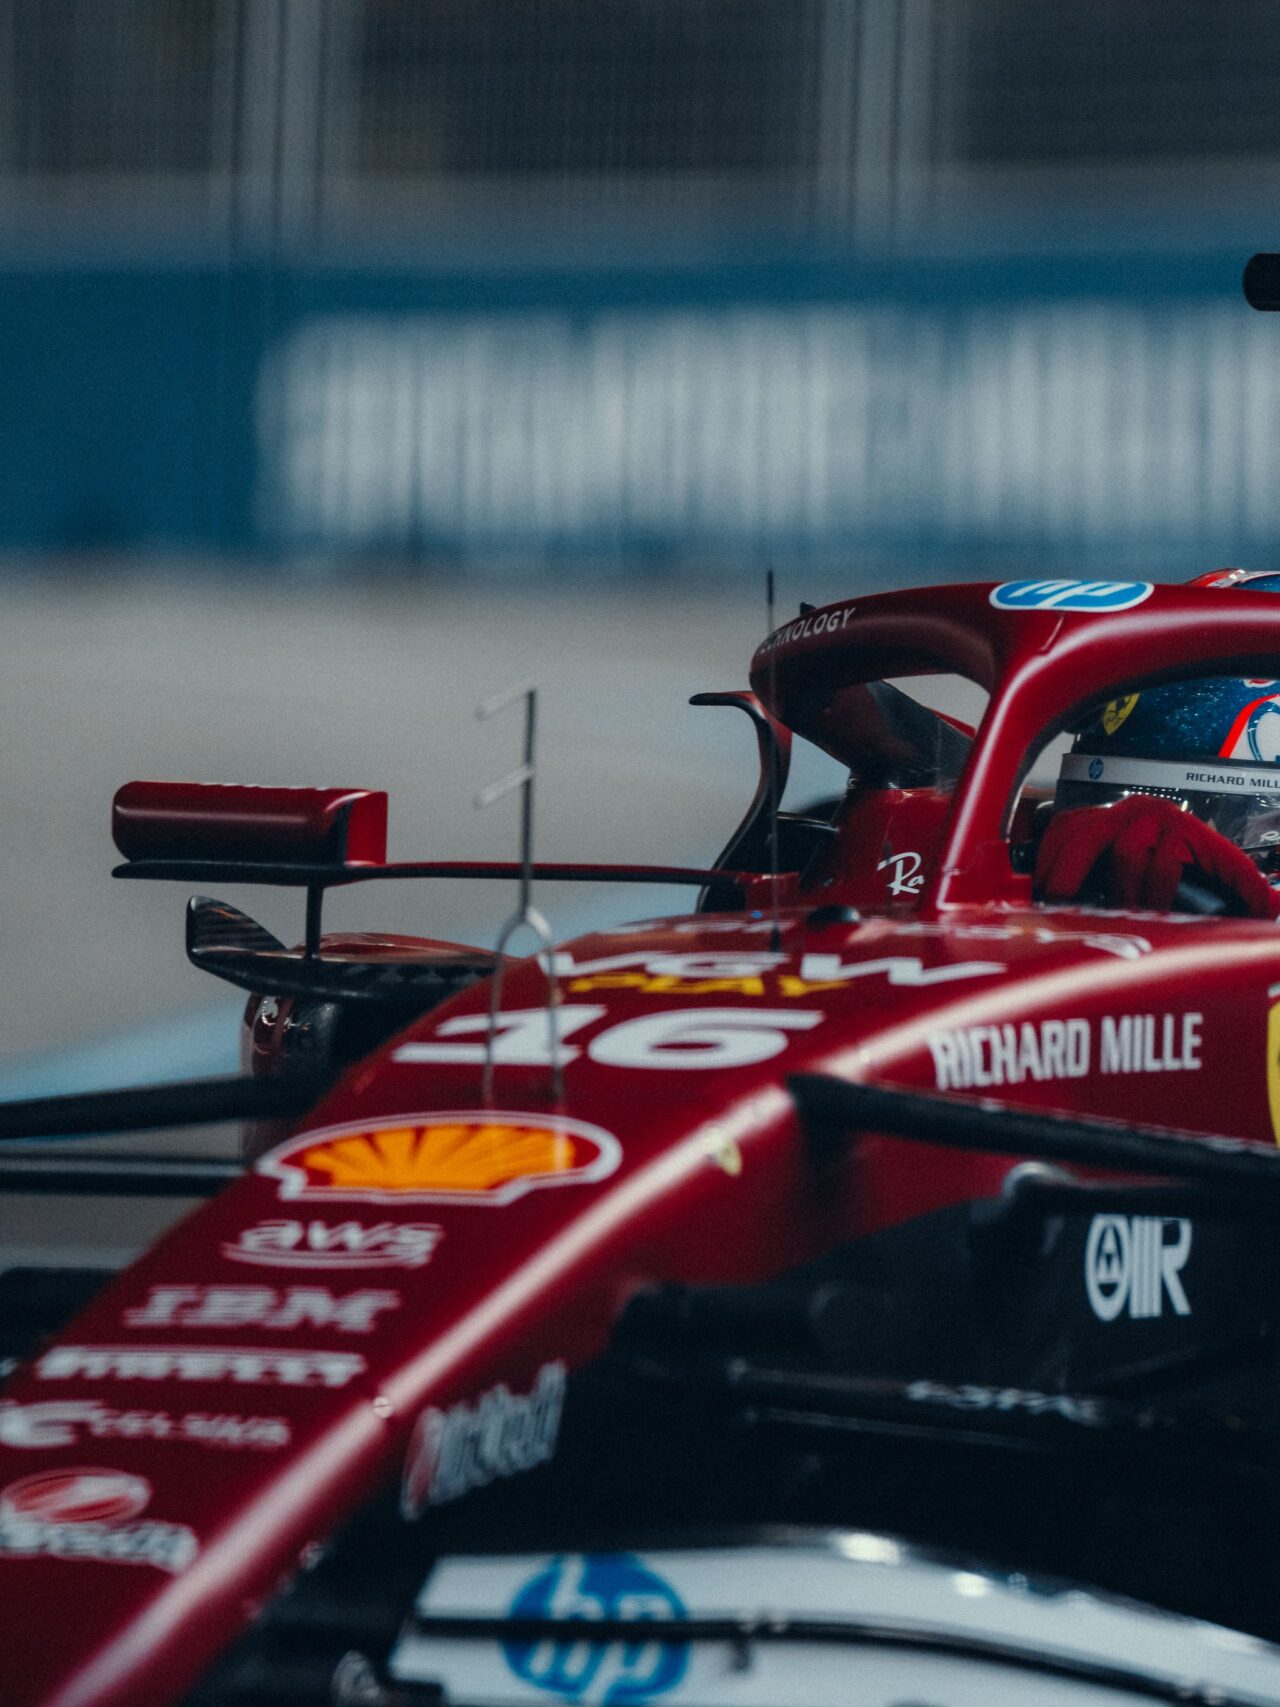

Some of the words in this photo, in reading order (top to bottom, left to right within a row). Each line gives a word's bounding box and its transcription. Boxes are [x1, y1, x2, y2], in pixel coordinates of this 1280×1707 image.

[1186, 772, 1245, 786] RICHARD
[391, 1004, 824, 1069] 16
[928, 1018, 1091, 1091] RICHARD
[1101, 1012, 1203, 1075] MILLE
